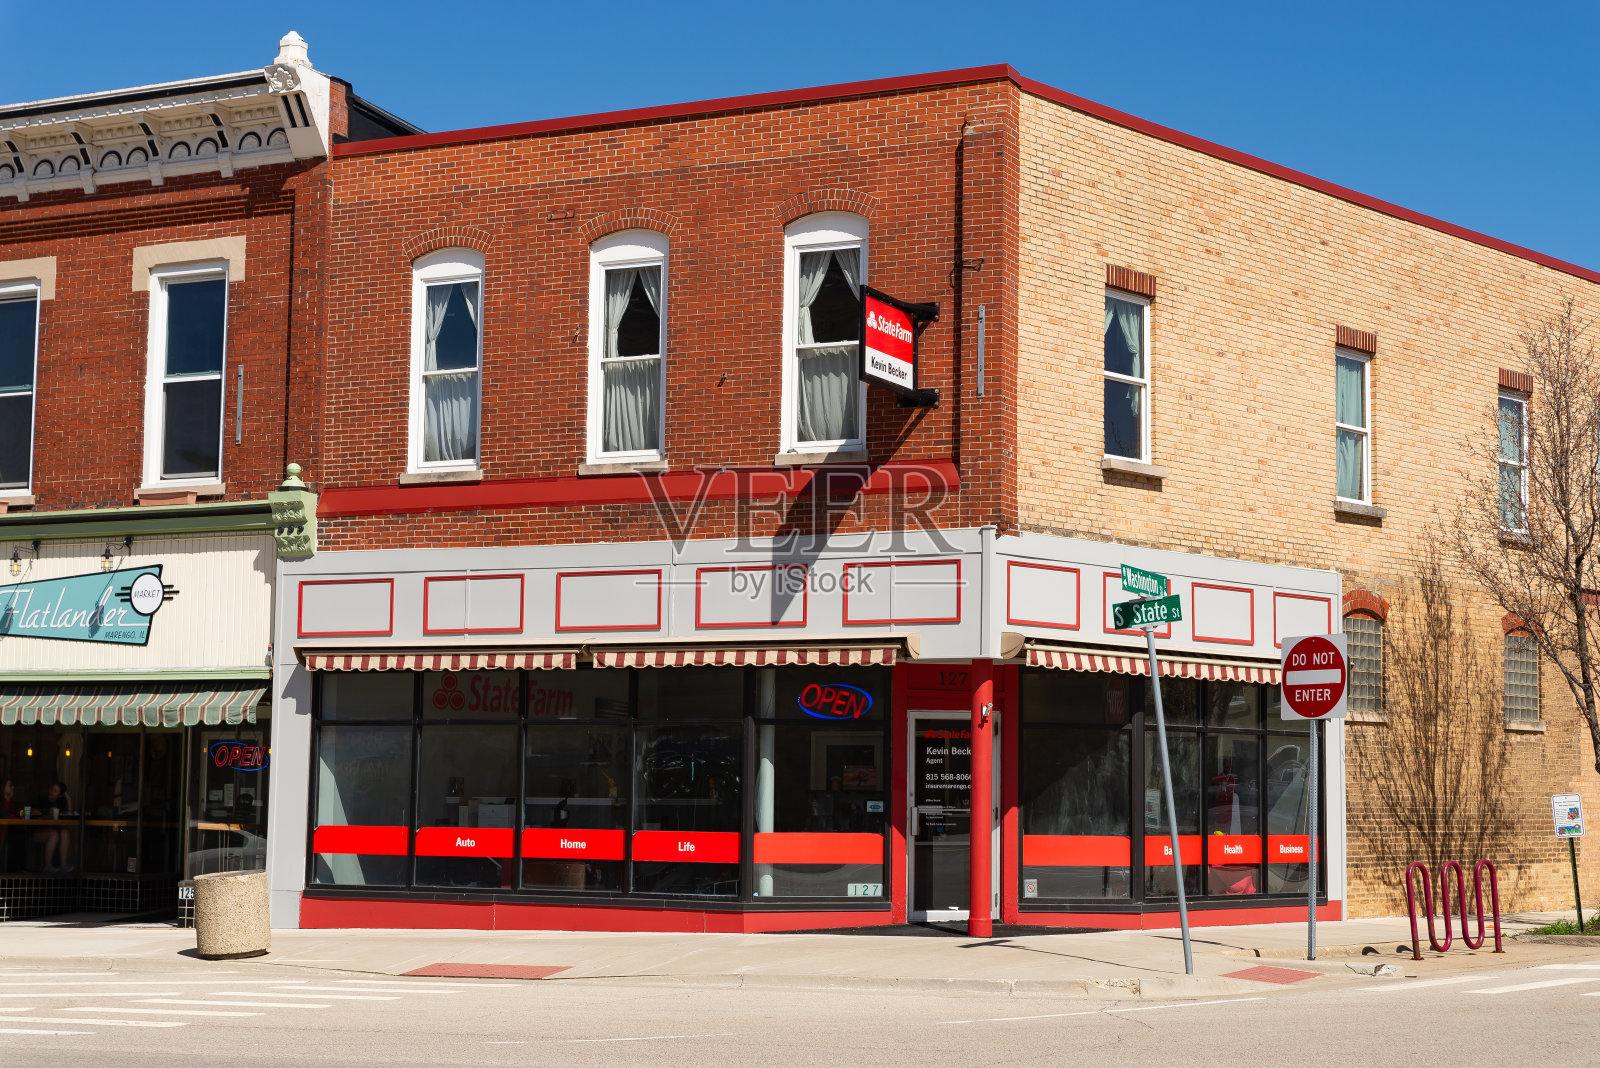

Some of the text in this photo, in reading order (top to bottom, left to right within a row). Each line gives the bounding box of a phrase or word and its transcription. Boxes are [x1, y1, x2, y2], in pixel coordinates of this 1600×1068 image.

[871, 355, 907, 380] Kevin Becker
[1126, 567, 1159, 596] Washington
[133, 589, 161, 598] MARKET
[0, 585, 149, 629] Flatlander
[1115, 601, 1180, 626] S State St
[139, 630, 145, 639] IL
[1292, 651, 1335, 666] DO NOT
[938, 671, 968, 686] 127
[801, 683, 867, 719] OPEN
[1295, 688, 1331, 702] ENTER
[215, 745, 266, 767] OPEN
[926, 746, 971, 755] Kevin Beck
[925, 757, 943, 765] Agent
[925, 773, 939, 781] 815
[455, 837, 476, 848] Auto
[560, 838, 587, 850] Home
[678, 841, 696, 853] Life
[1224, 844, 1243, 855] Health
[1279, 844, 1304, 854] Business
[180, 887, 195, 899] 125
[853, 884, 879, 896] 127
